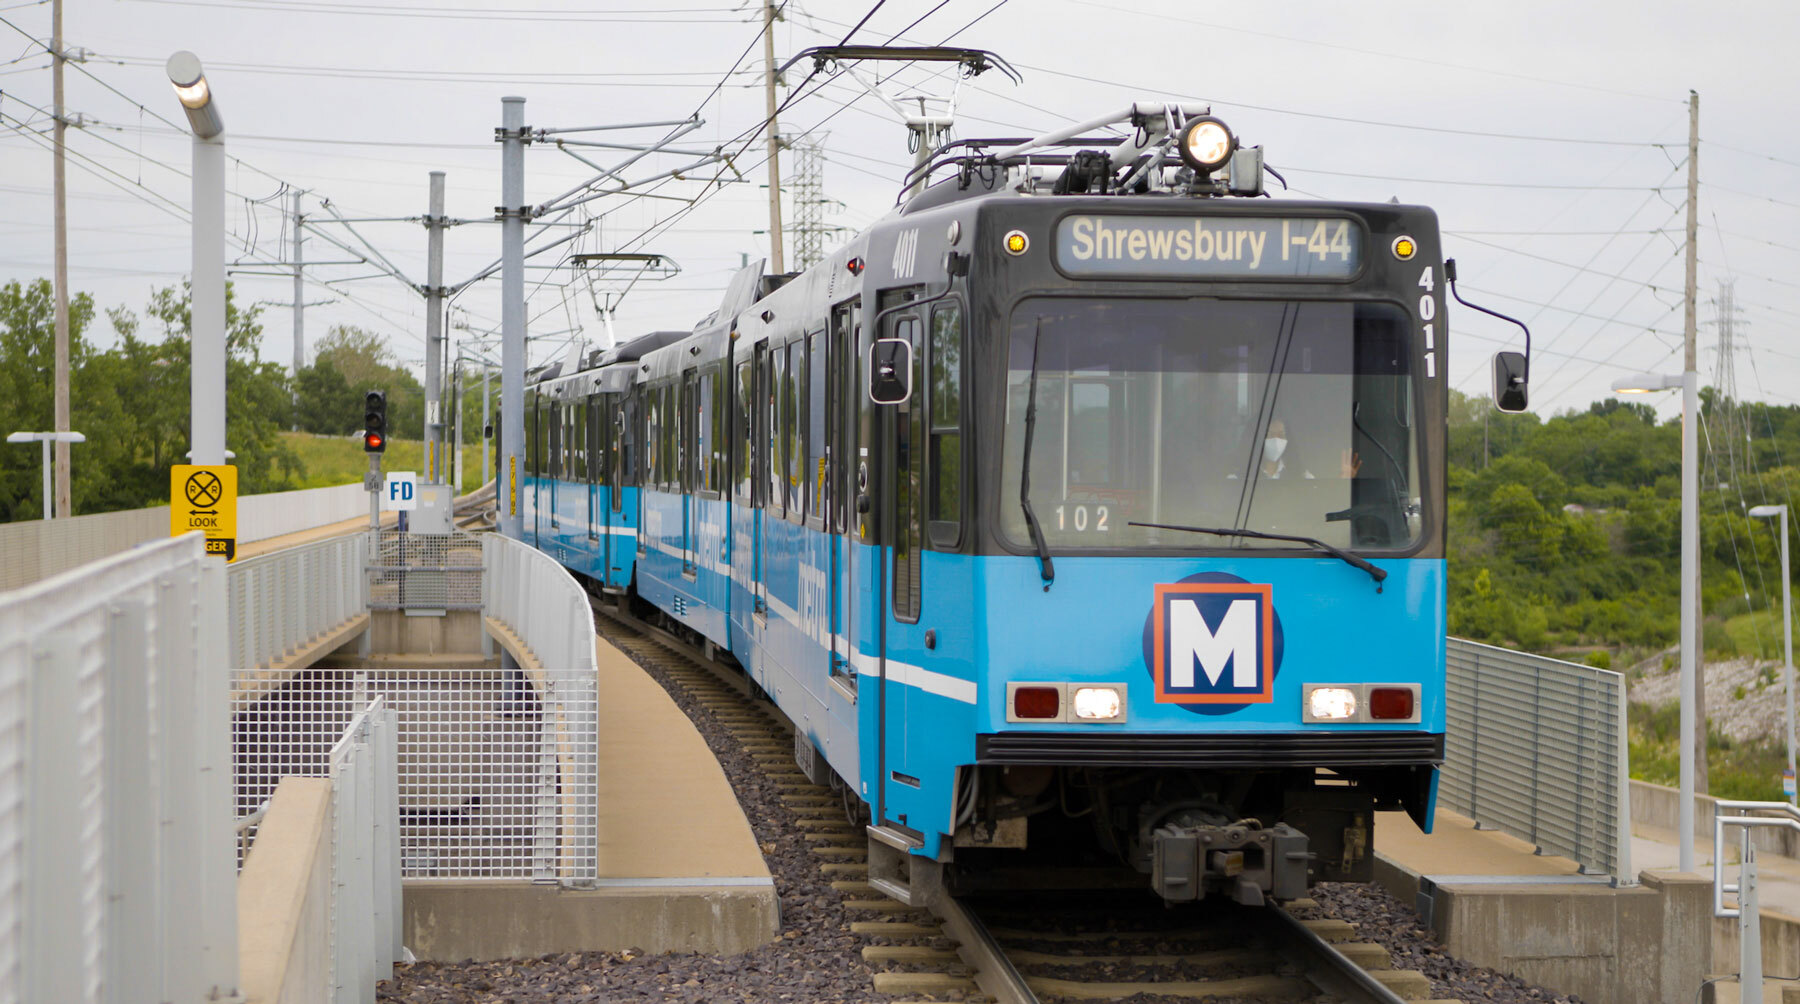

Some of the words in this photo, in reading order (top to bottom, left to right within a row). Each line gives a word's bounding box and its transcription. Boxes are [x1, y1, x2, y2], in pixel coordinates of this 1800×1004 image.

[892, 228, 919, 279] 4011
[1071, 217, 1266, 269] Shrewsbury
[1281, 220, 1352, 261] I-44
[1418, 265, 1436, 378] 4011
[189, 485, 197, 494] R
[211, 485, 218, 494] R
[390, 481, 413, 501] FD
[189, 517, 218, 527] LOOK
[1056, 505, 1109, 531] 102
[204, 540, 227, 552] GER
[1170, 599, 1257, 688] M
